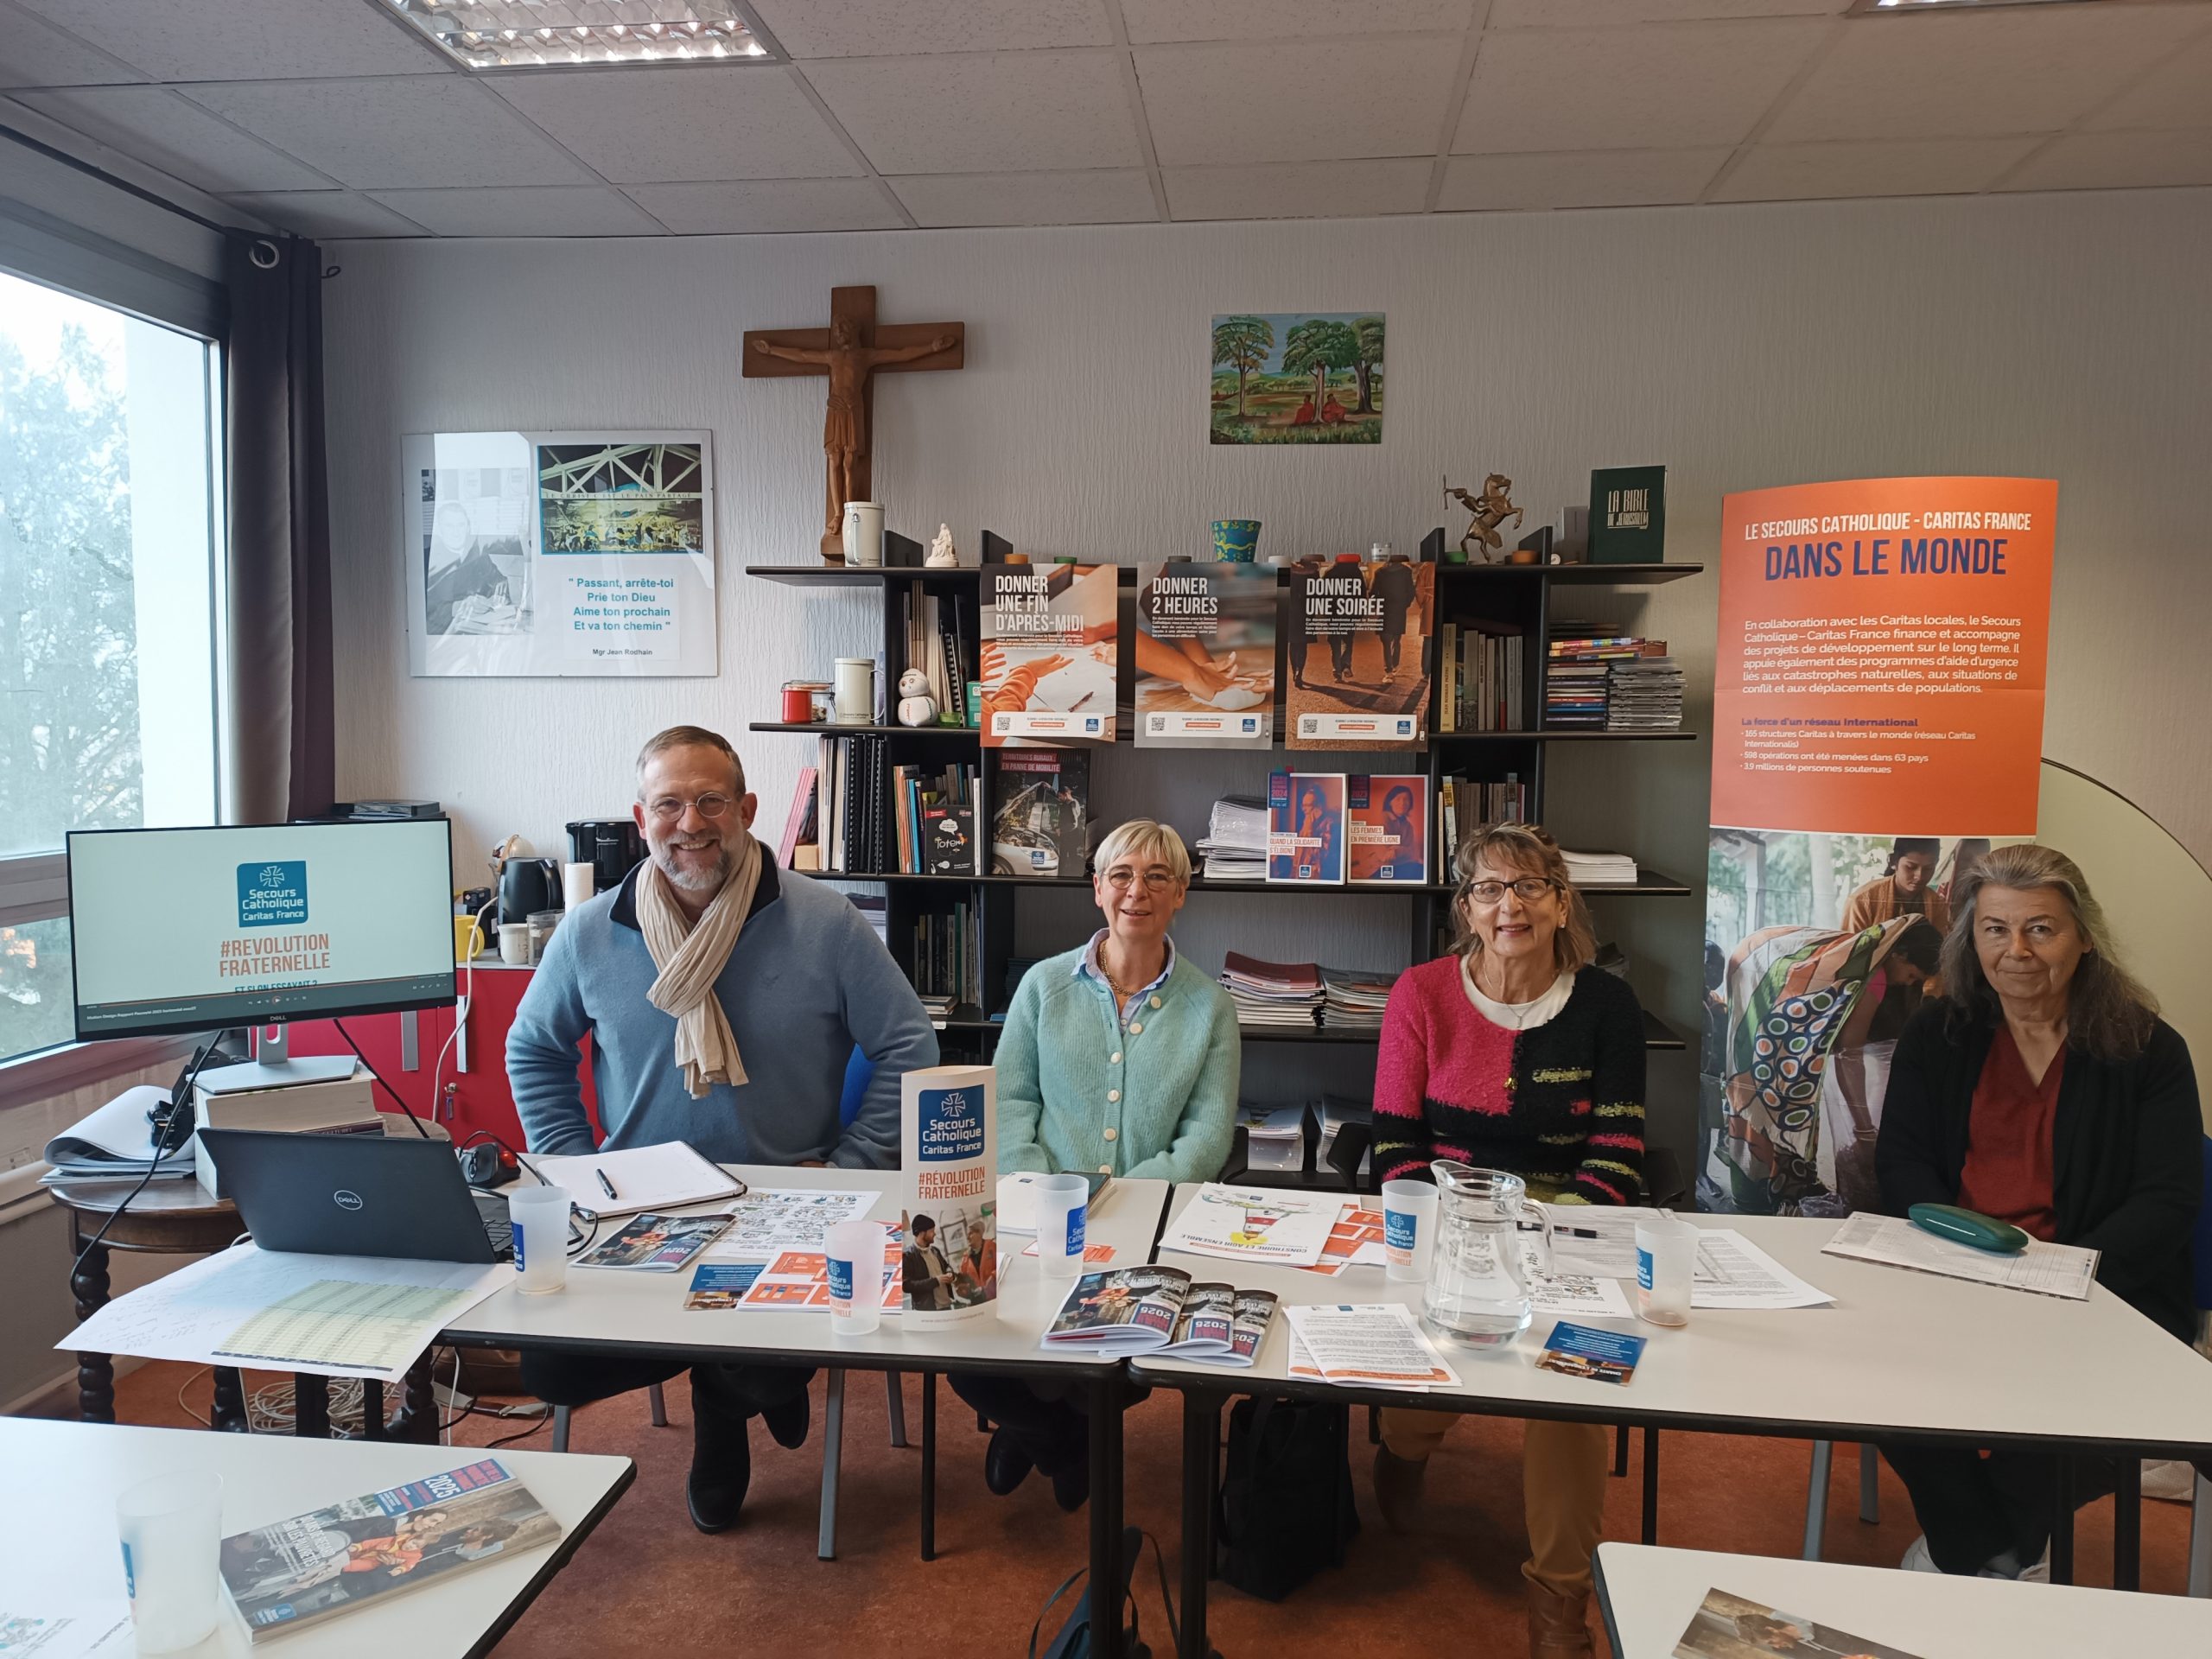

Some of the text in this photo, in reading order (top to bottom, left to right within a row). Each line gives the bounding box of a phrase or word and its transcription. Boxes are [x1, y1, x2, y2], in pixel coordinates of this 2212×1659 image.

[1608, 488, 1649, 512] LA BIBLE
[1745, 524, 1759, 540] LE
[1761, 518, 1818, 539] SECOURS
[1821, 512, 1910, 533] CATHOLIQUE
[1923, 512, 1981, 529] CARITAS
[1984, 512, 2031, 531] FRANCE
[1765, 537, 2008, 581] DANS LE MONDE
[576, 578, 674, 588] Passant, arrête-toi
[995, 575, 1048, 593] DONNER
[1153, 577, 1208, 594] DONNER
[1306, 578, 1362, 595] DONNER
[588, 593, 608, 601] Prie
[632, 593, 655, 601] Dieu
[996, 594, 1048, 612] UNE FIN
[1153, 597, 1217, 614] 2 HEURES
[1306, 594, 1384, 615] UNE SOIRÉE
[574, 607, 671, 618] Aime ton prochain
[574, 621, 585, 630] Et
[623, 621, 662, 630] chemin
[996, 611, 1084, 631] D'APRÈS-MIDI
[1745, 615, 2021, 630] En collaboration avec les Caritas locales, le Secours
[1745, 629, 2020, 643] Catholique Caritas France finance et accompagne
[1744, 645, 1761, 655] des
[1764, 645, 1799, 657] projets
[1801, 644, 1816, 653] de
[1819, 643, 1914, 654] développement
[1939, 642, 1949, 652] le
[1953, 643, 1977, 654] long
[1980, 644, 2011, 652] terme.
[2013, 644, 2019, 653] Il
[1744, 656, 2018, 670] appuie également des programmes d'aide d'urgence
[1743, 671, 1759, 681] liés
[1783, 670, 1858, 681] catastrophes
[1860, 669, 1925, 680] naturelles,
[1952, 670, 2002, 680] situations
[2005, 671, 2018, 680] de
[1743, 683, 1772, 693] conflit
[1774, 684, 1784, 693] et
[1809, 683, 1895, 695] déplacements
[1897, 683, 1913, 692] de
[1916, 683, 1983, 695] populations.
[1844, 718, 1918, 727] International
[1759, 752, 1798, 760] opérations
[1358, 835, 1382, 843] PREMIÈRE
[249, 889, 296, 899] Secours
[242, 899, 303, 909] Catholique
[243, 910, 304, 921] Caritas France
[219, 952, 330, 977] FRATERNELLE
[930, 1117, 976, 1130] Secours
[923, 1128, 982, 1141] Catholique
[923, 1141, 982, 1154] Caritas France
[918, 1166, 985, 1185] #RÉVOLUTION
[918, 1180, 985, 1199] FRATERNELLE
[1140, 1306, 1172, 1319] 2025
[1195, 1320, 1227, 1330] 2025
[424, 1474, 461, 1498] 2025
